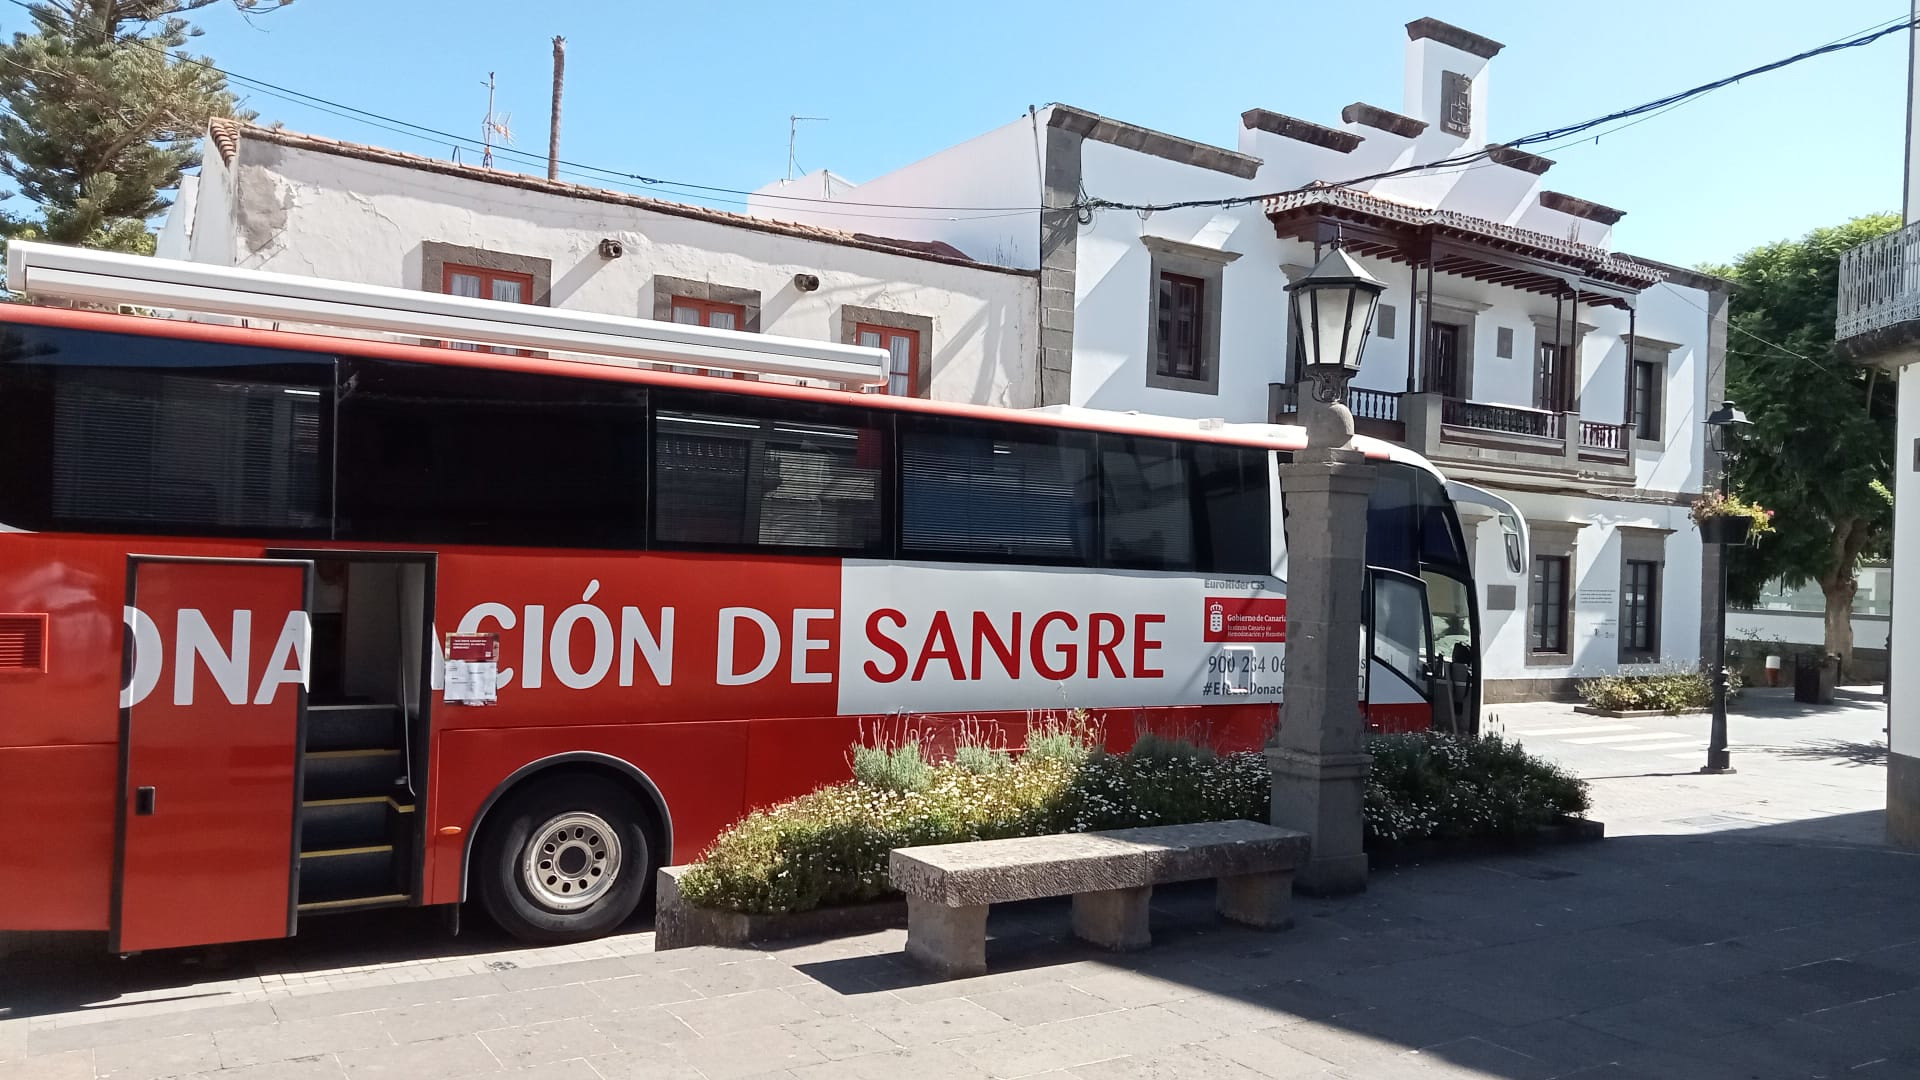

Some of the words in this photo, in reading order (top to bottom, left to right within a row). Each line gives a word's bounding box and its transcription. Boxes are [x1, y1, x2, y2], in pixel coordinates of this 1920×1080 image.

[1204, 579, 1250, 590] EuroRider
[1227, 613, 1256, 622] Gobierno
[1256, 613, 1264, 622] de
[716, 606, 835, 686] DE
[863, 608, 1166, 683] SANGRE
[1208, 655, 1236, 673] 900
